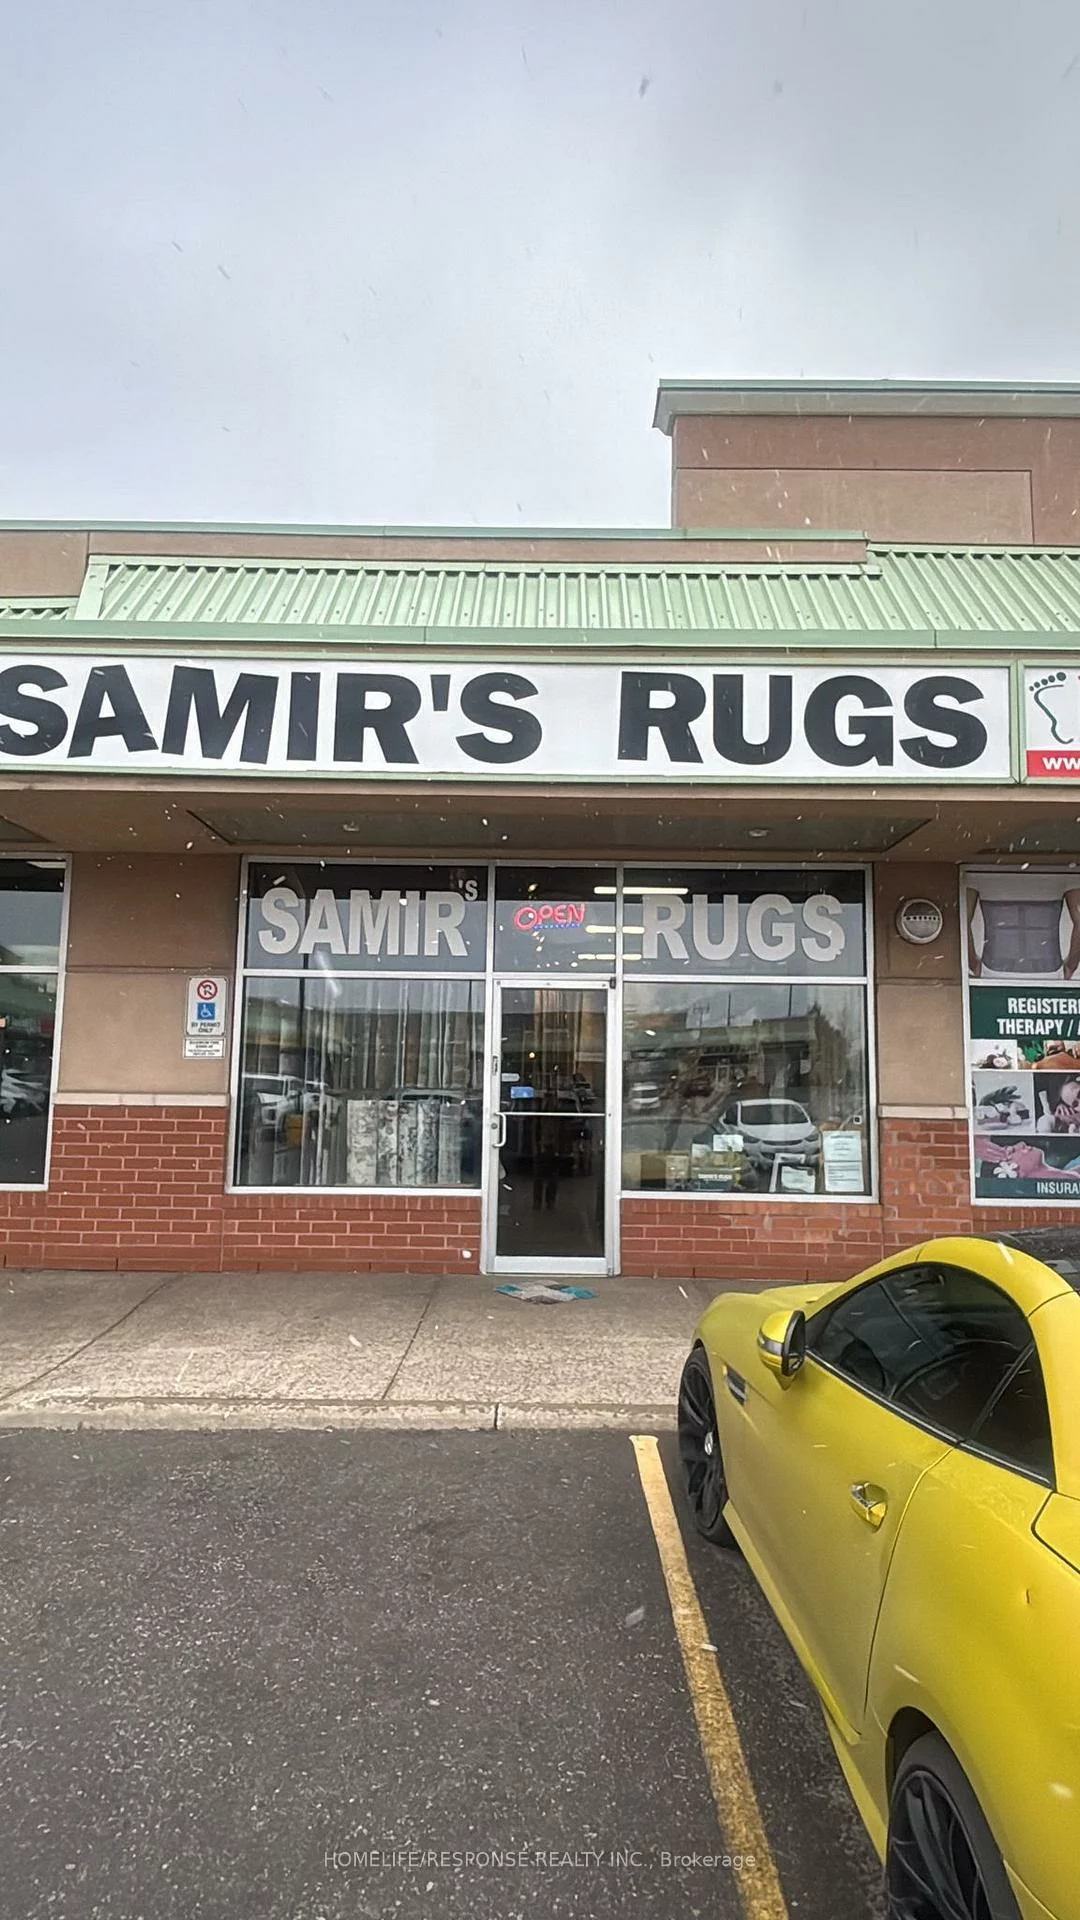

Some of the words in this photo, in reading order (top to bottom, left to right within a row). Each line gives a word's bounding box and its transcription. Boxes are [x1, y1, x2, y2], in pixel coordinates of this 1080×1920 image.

[0, 664, 542, 764] SAMIR'S
[617, 671, 988, 768] RUGS
[513, 903, 585, 932] OPEN
[642, 894, 845, 962] RUGS
[996, 1018, 1064, 1035] THERAPY
[1036, 1182, 1080, 1194] INSURA
